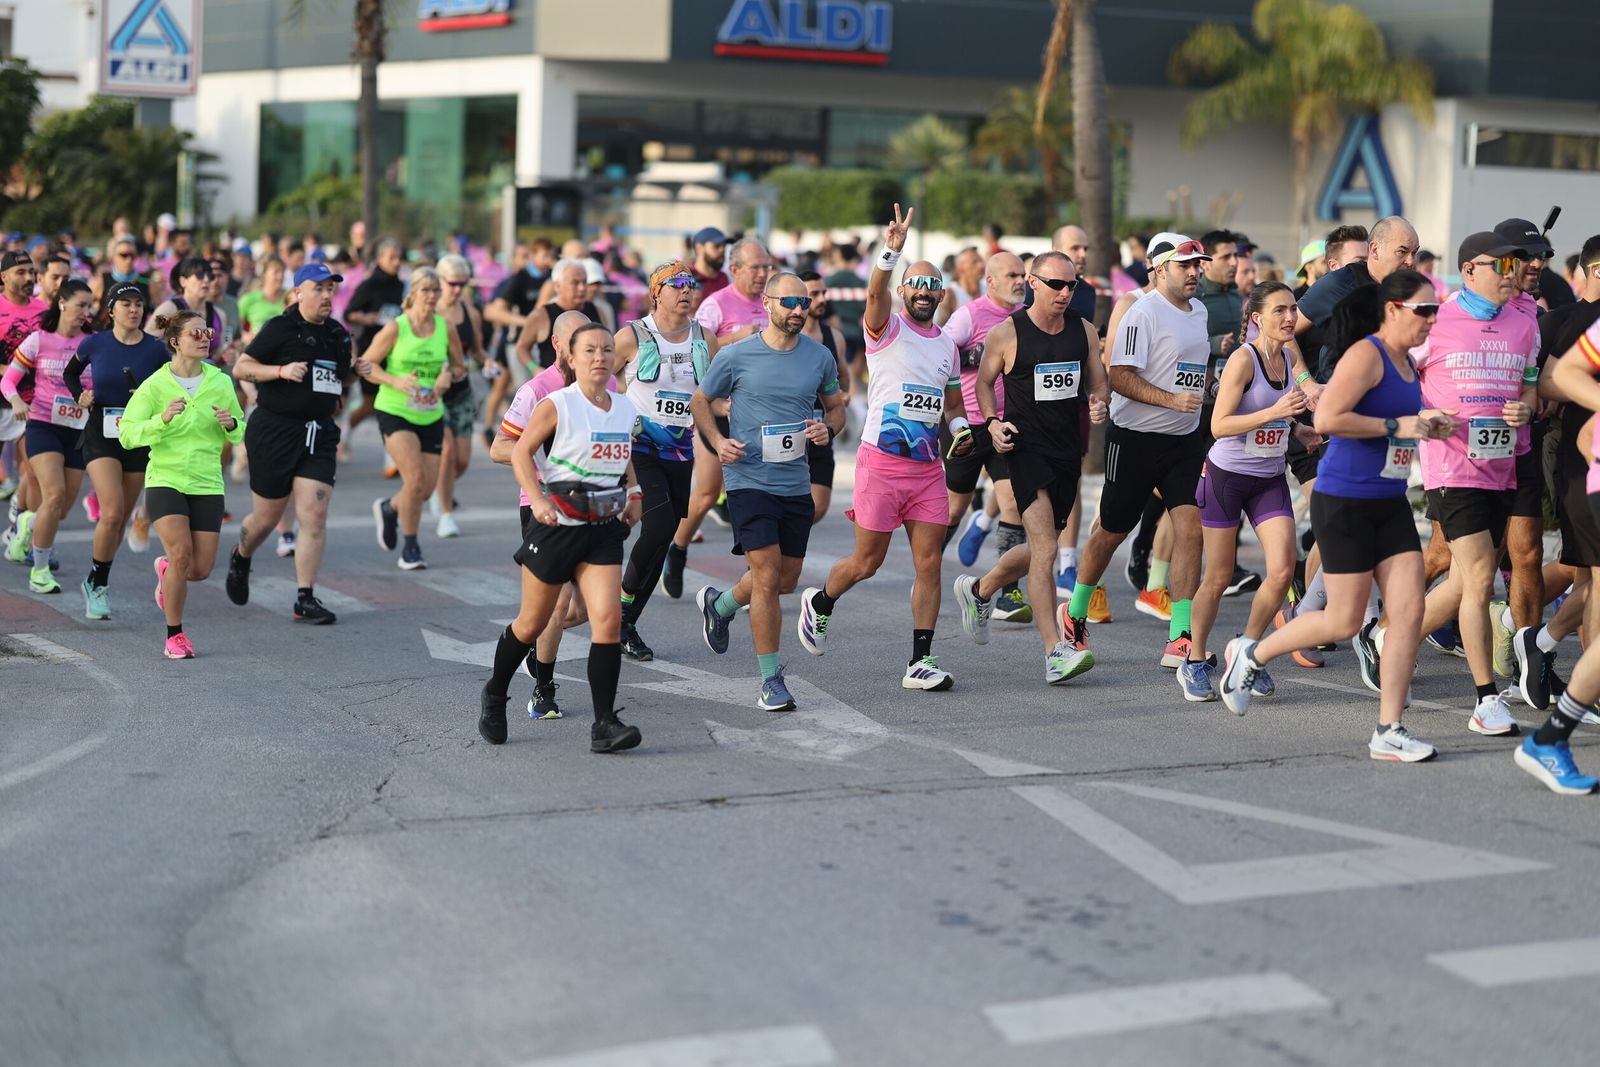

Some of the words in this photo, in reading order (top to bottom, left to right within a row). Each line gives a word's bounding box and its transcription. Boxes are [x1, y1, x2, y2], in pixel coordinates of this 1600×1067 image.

[717, 0, 892, 52] ALDI
[113, 60, 184, 82] ALDI
[1480, 340, 1507, 351] XXXVI
[1445, 352, 1483, 368] MEDIA
[1043, 373, 1074, 389] 596
[1175, 372, 1204, 388] 2026
[1452, 369, 1510, 380] INTERNACIONAL
[656, 400, 691, 415] 1894
[903, 393, 941, 412] 2244
[58, 405, 83, 419] 820
[782, 435, 793, 449] 6
[1255, 430, 1285, 445] 887
[1478, 429, 1511, 446] 375
[592, 443, 630, 460] 2435
